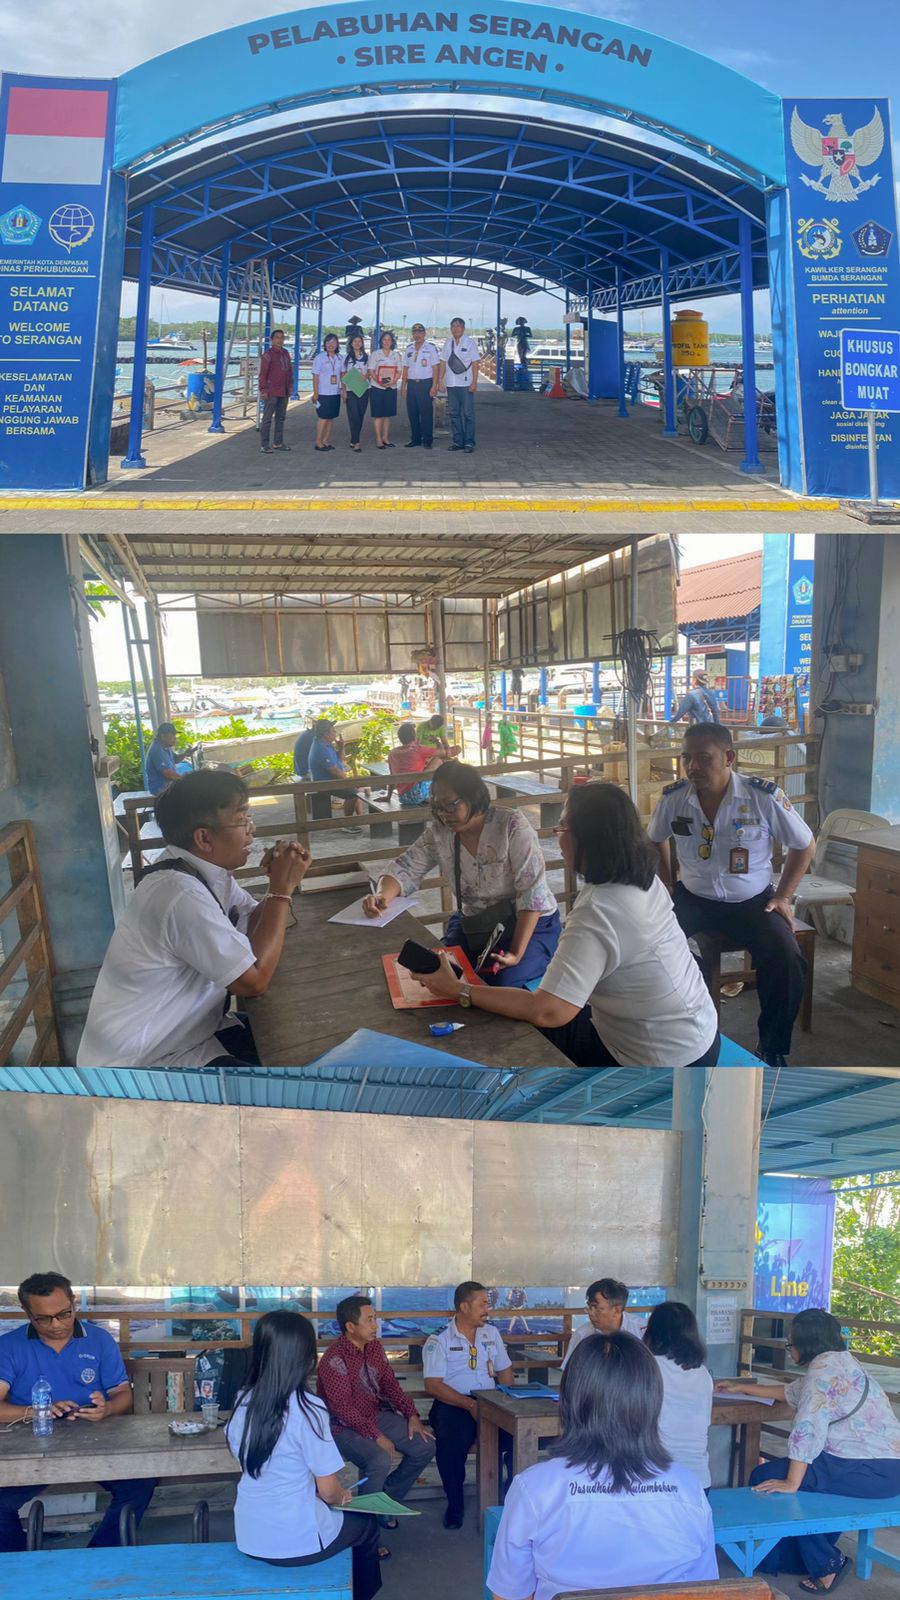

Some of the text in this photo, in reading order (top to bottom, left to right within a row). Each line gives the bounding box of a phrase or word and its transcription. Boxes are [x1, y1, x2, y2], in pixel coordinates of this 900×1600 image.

[248, 12, 652, 67] PELABUHAN SERANGAN
[354, 44, 548, 73] SIRE ANGEN
[23, 265, 89, 273] PERHUBUNGAN
[9, 286, 75, 298] SELAMAT
[812, 293, 886, 304] PERHATIAN
[13, 301, 69, 312] DATANG
[9, 322, 71, 332] WELCOME
[818, 330, 841, 338] WAJI
[14, 335, 82, 345] SERANGAN
[847, 339, 894, 355] KHUSUS
[845, 362, 898, 378] BONGKAR
[0, 372, 72, 381] KESELAMATAN
[23, 383, 45, 392] DAN
[857, 385, 890, 400] MUAT
[4, 394, 63, 403] KEAMANAN
[2, 405, 63, 414] PELAYARAN
[830, 411, 890, 419] JAGA JAAK
[0, 416, 80, 425] NGGUNG JAWAB
[6, 426, 56, 435] BERSAMA
[831, 434, 892, 442] DISINFETAN
[770, 1275, 809, 1297] Line
[569, 1481, 620, 1496] Vasudhai
